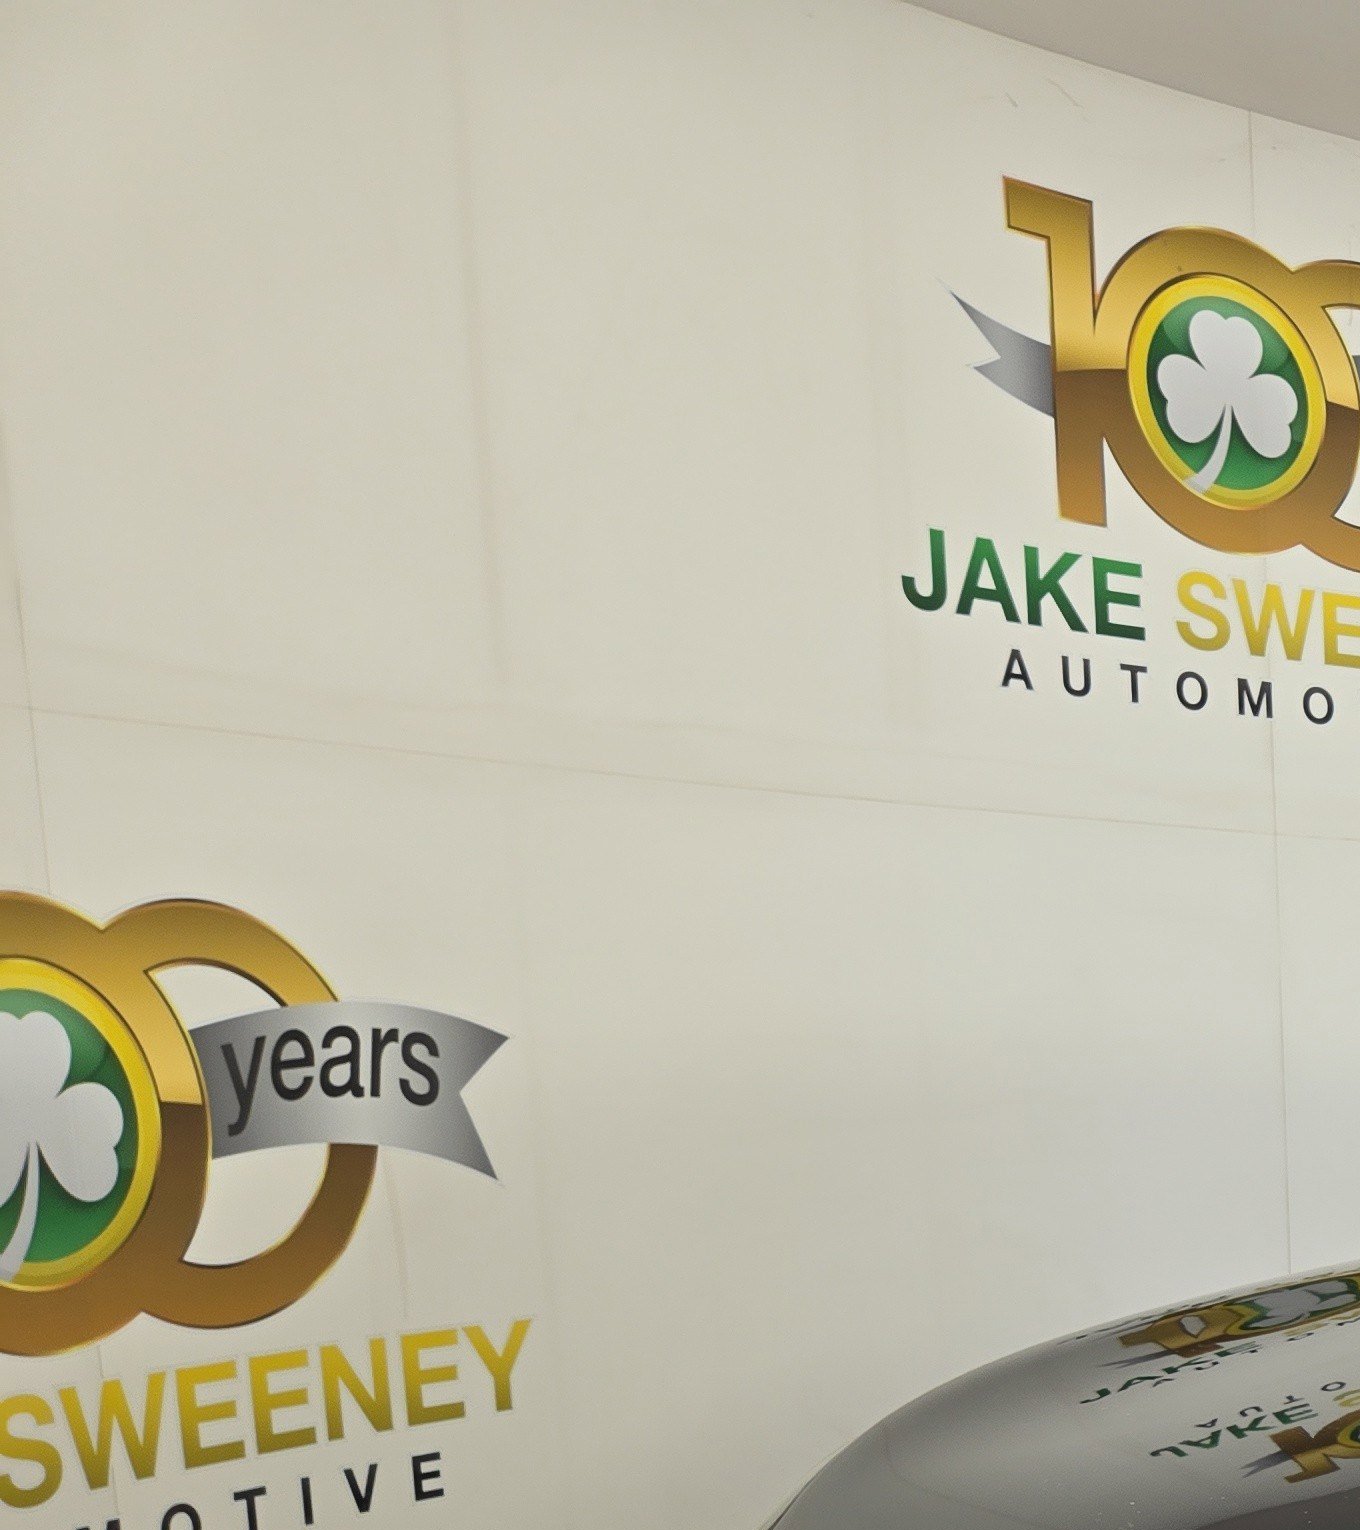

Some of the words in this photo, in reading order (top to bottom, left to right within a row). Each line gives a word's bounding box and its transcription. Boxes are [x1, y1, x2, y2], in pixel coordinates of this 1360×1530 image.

[900, 526, 1147, 642] JAKE
[220, 1023, 442, 1138] years
[0, 1318, 533, 1510] SWEENEY
